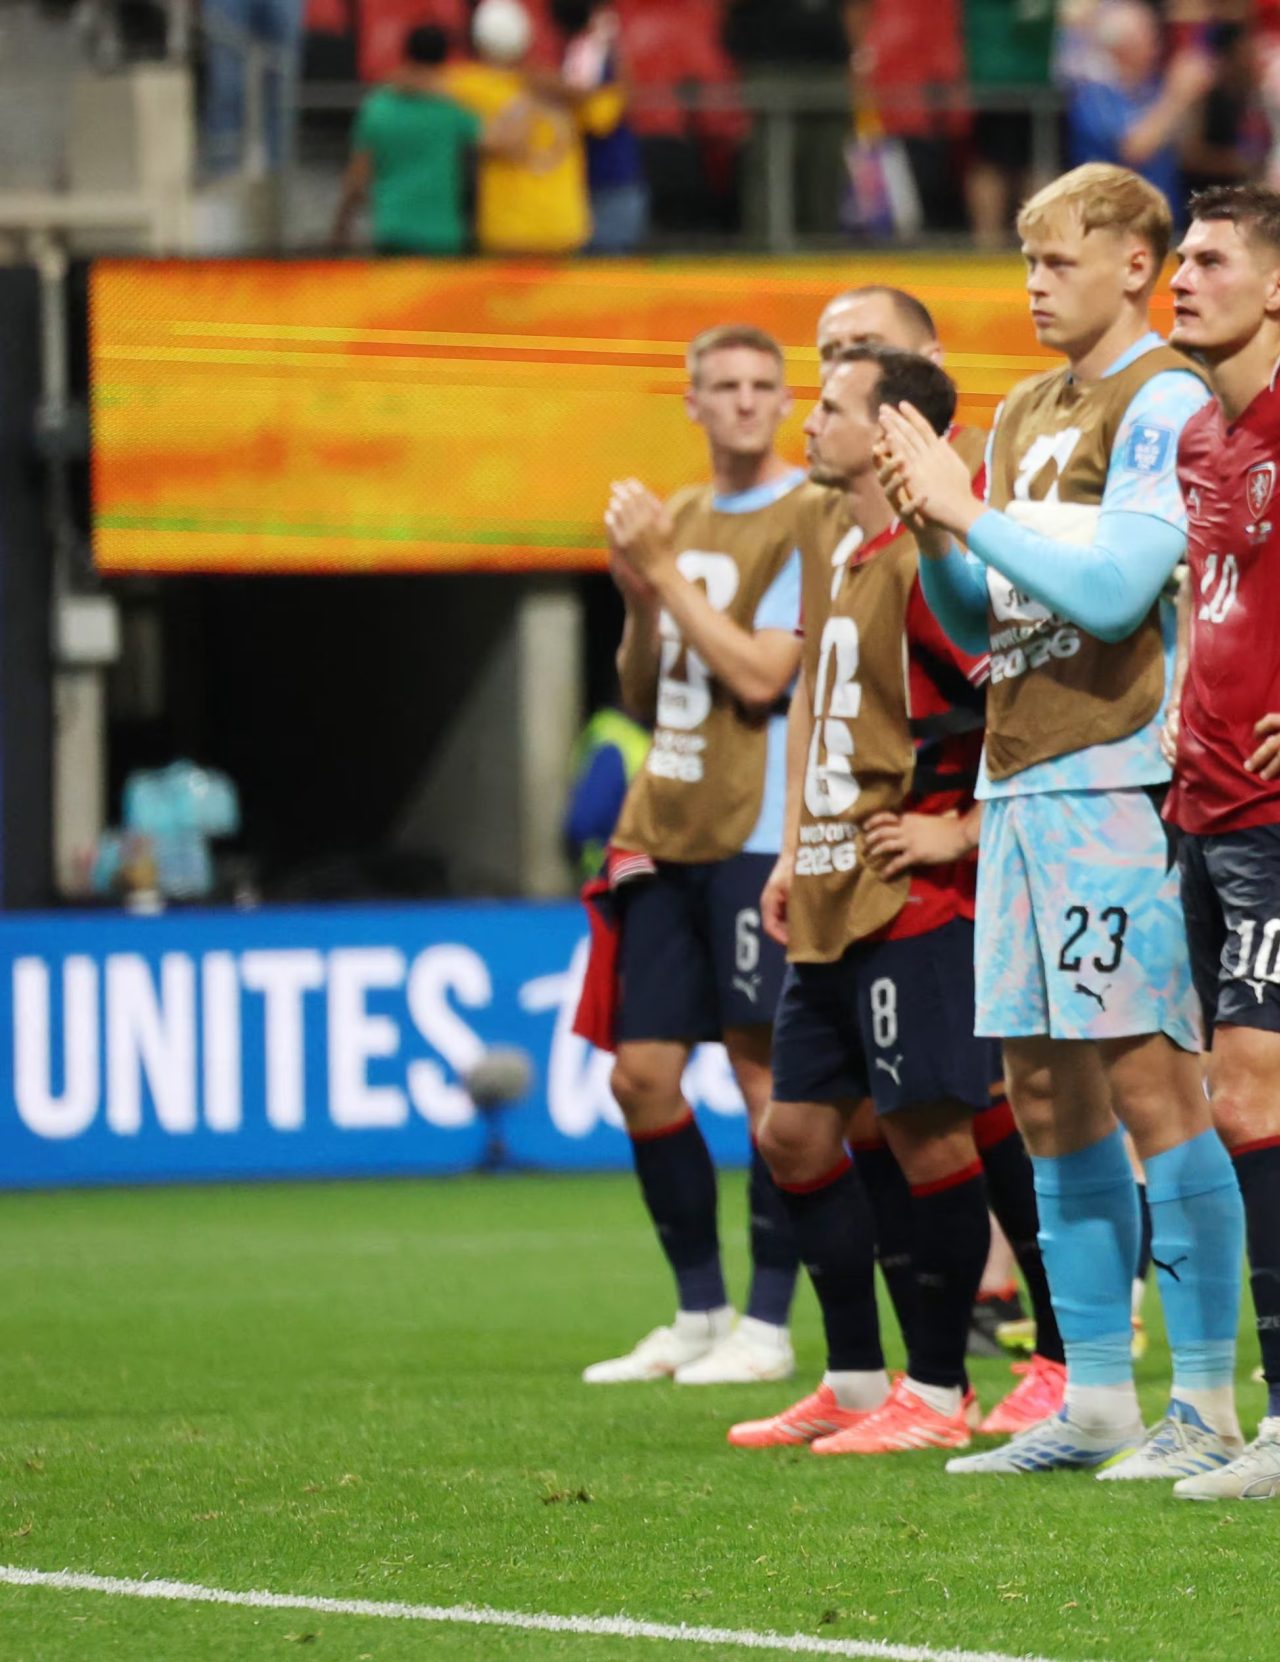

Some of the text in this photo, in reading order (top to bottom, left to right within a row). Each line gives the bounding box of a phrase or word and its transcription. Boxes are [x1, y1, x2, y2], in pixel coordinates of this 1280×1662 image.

[1198, 553, 1239, 624] 10
[990, 628, 1081, 685] 2026
[735, 907, 760, 972] 6
[1059, 905, 1127, 973] 23
[11, 943, 494, 1139] UNITES
[870, 976, 898, 1048] 8
